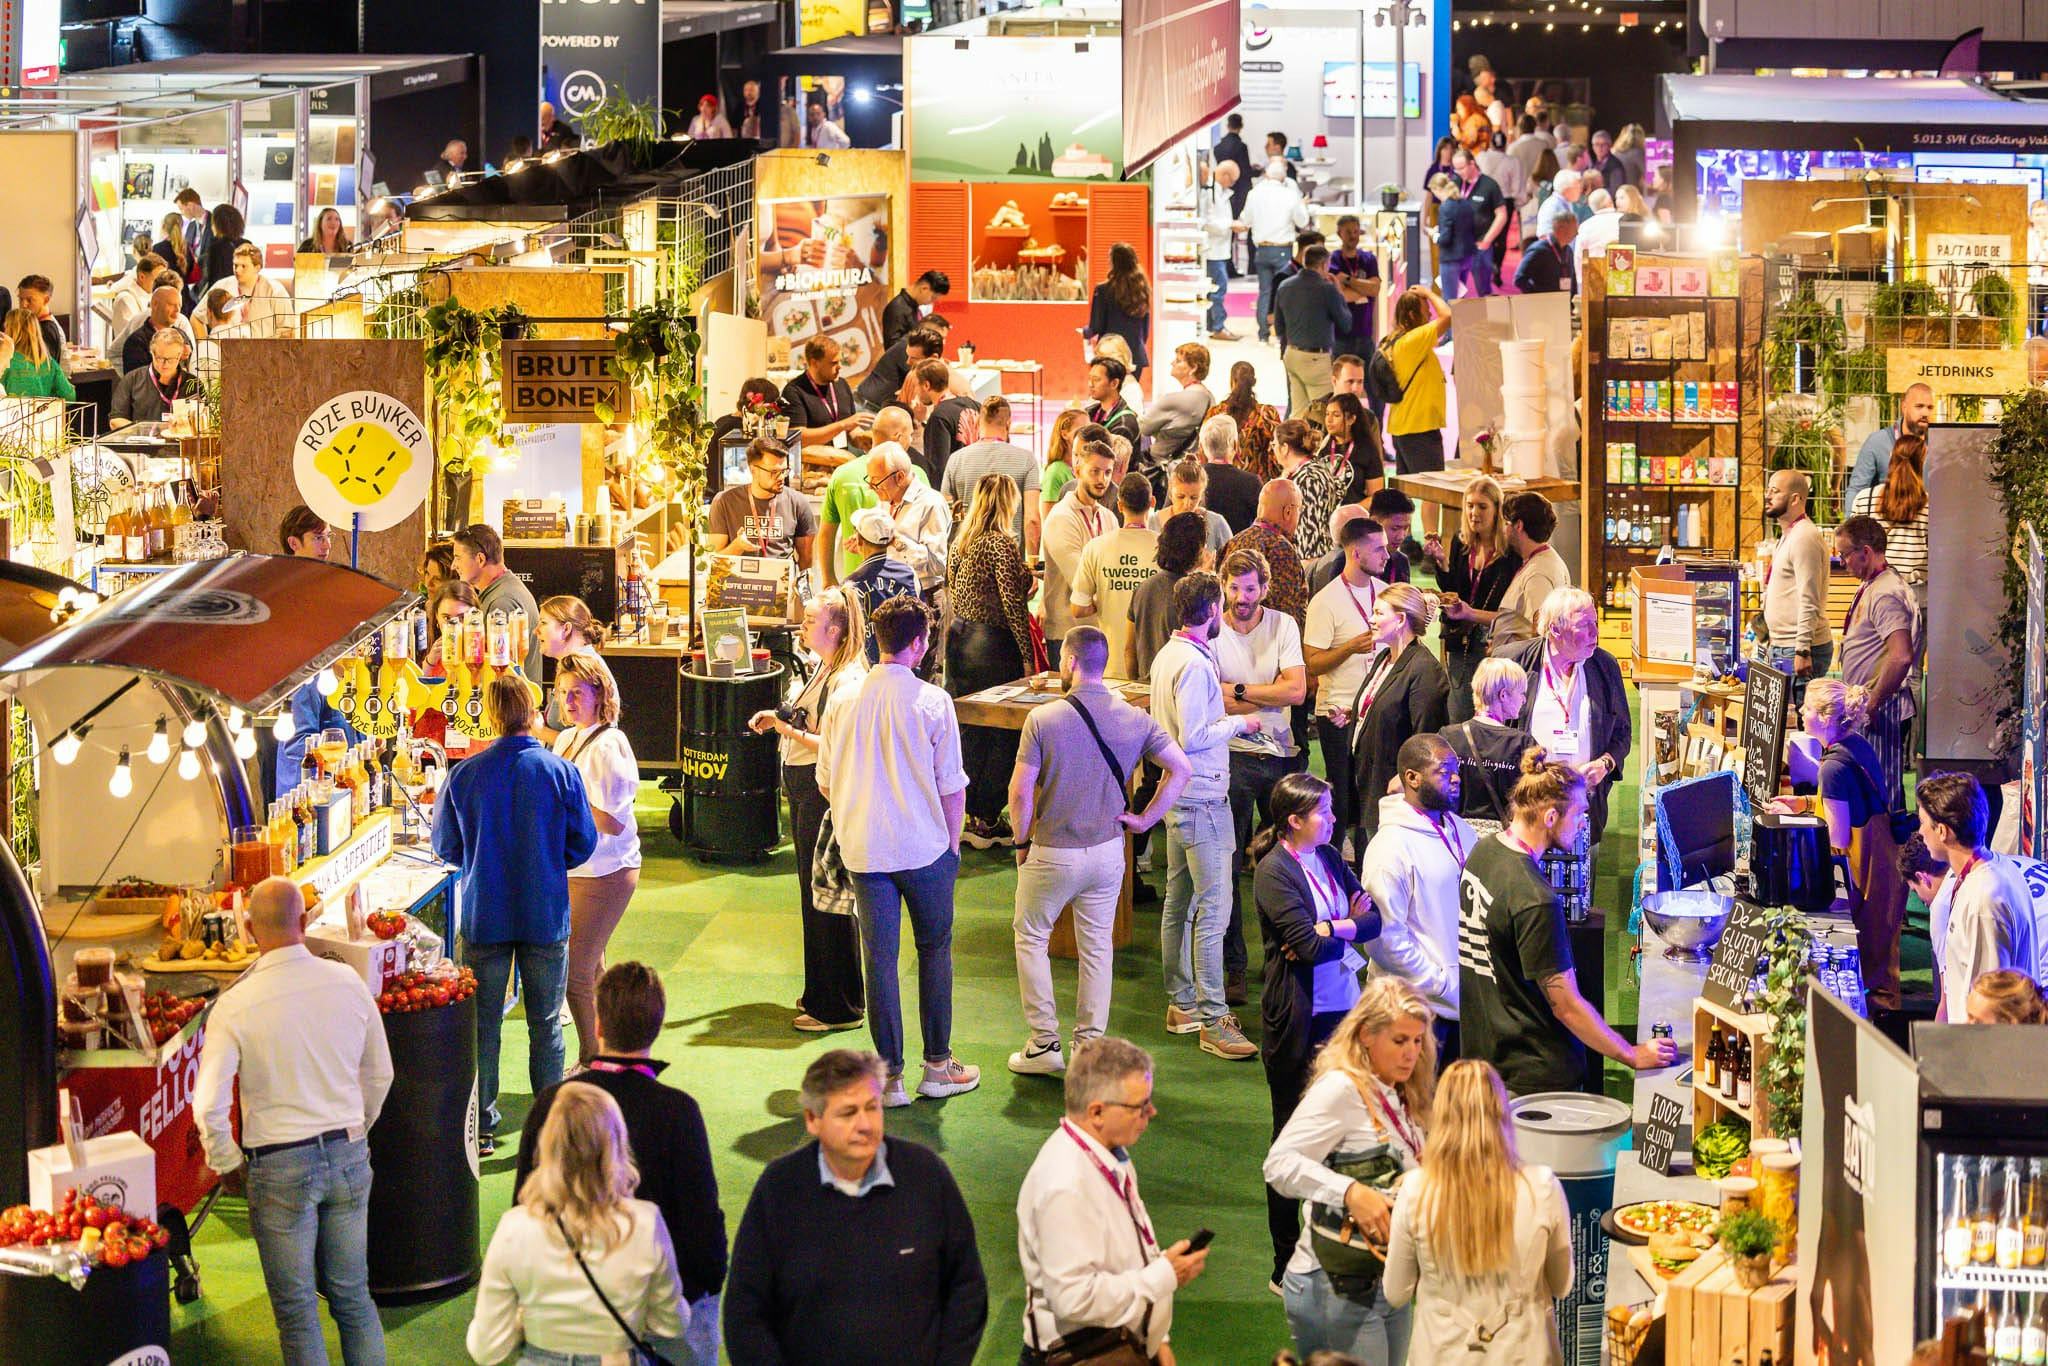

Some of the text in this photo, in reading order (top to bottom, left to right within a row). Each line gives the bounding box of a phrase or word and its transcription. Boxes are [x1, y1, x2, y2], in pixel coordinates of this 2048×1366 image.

[541, 36, 619, 47] POWERED BY
[1912, 134, 1943, 145] 5.012
[1946, 134, 1967, 145] SVH
[1970, 134, 2027, 148] (Stichting
[517, 356, 615, 377] BRUTE
[1917, 365, 1995, 378] JETDRINKS
[517, 387, 616, 408] BONEN
[302, 395, 422, 452] ROZE BUNKER
[746, 517, 781, 527] BUE
[1102, 566, 1158, 578] tweede
[1119, 554, 1138, 565] de
[1750, 716, 1773, 745] TASTING
[1731, 902, 1753, 929] Dé
[1721, 927, 1761, 958] GLUTEN
[1722, 946, 1750, 972] VRIJE
[1708, 963, 1751, 996] SPECIALIST
[140, 1058, 202, 1140] FELLO
[1650, 1096, 1682, 1128] 100%
[1645, 1123, 1674, 1150] GLUTEN
[1641, 1142, 1668, 1172] VRIJ
